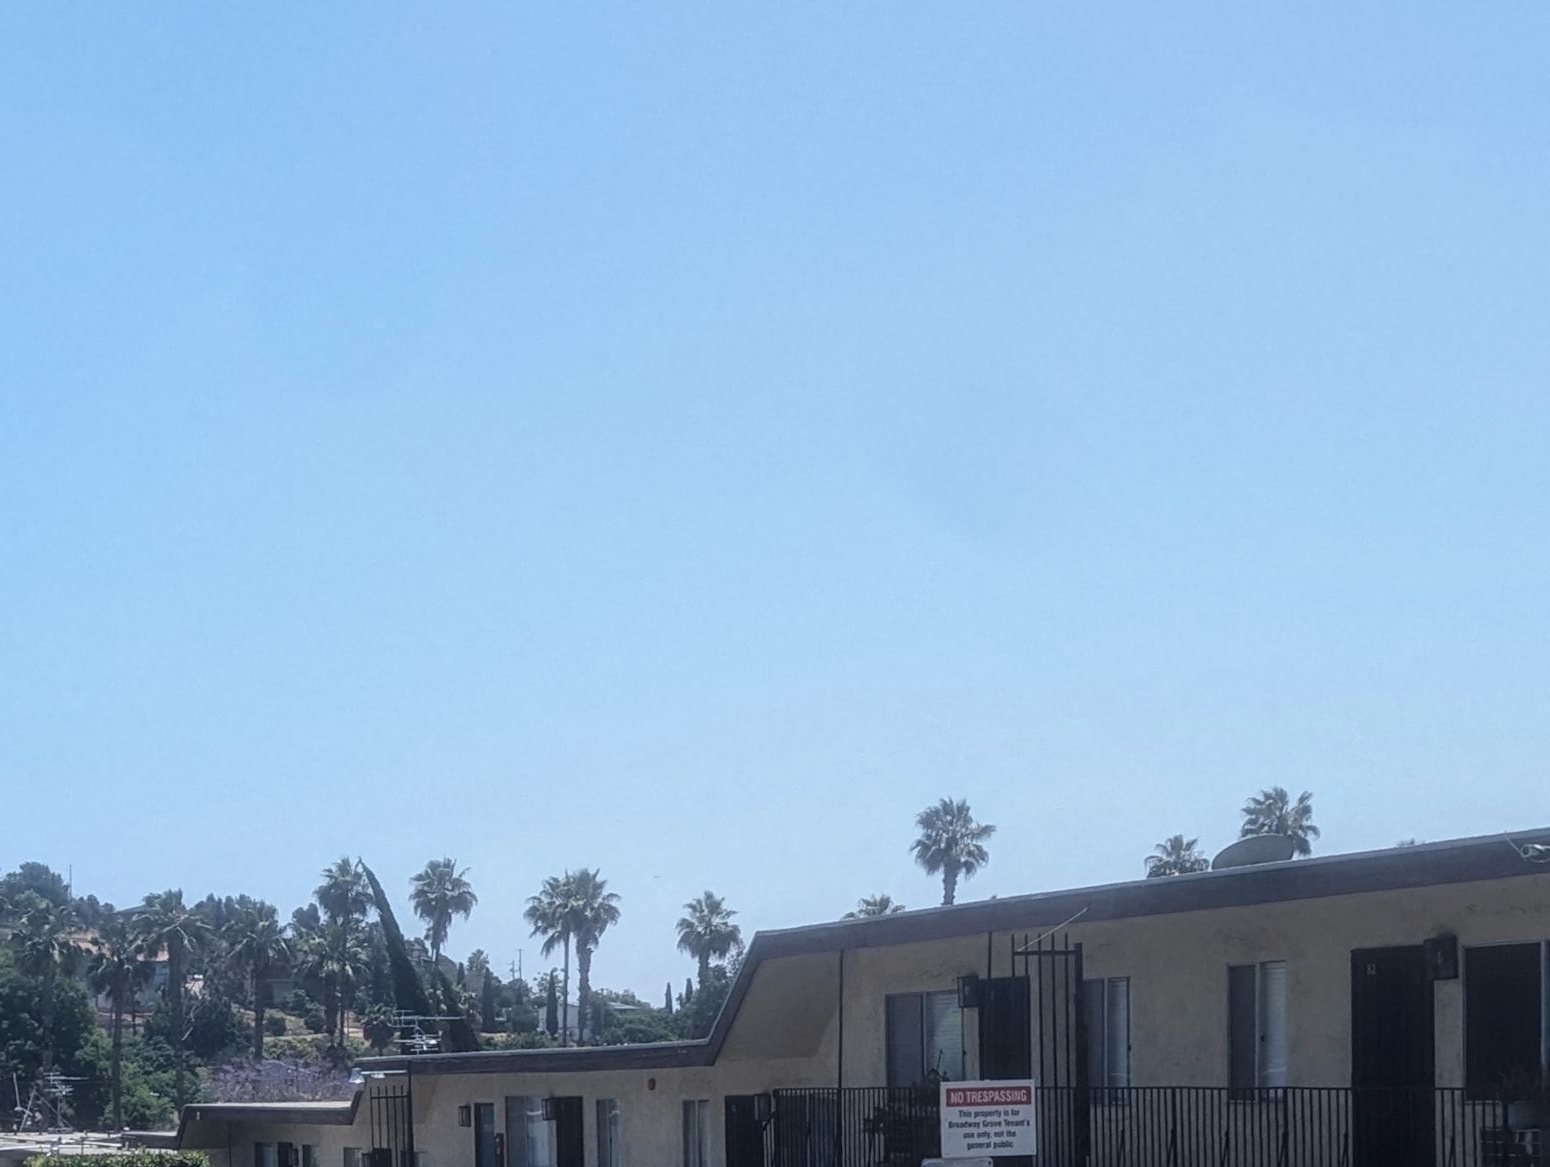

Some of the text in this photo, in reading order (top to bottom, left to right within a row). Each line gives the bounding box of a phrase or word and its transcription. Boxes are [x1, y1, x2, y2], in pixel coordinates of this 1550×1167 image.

[950, 1089, 1027, 1104] NO TRESPASSING
[958, 1108, 1020, 1118] This property is for
[948, 1119, 1030, 1129] Broadway Grove Tenant's
[994, 1130, 1004, 1138] not
[967, 1140, 1013, 1150] general public
